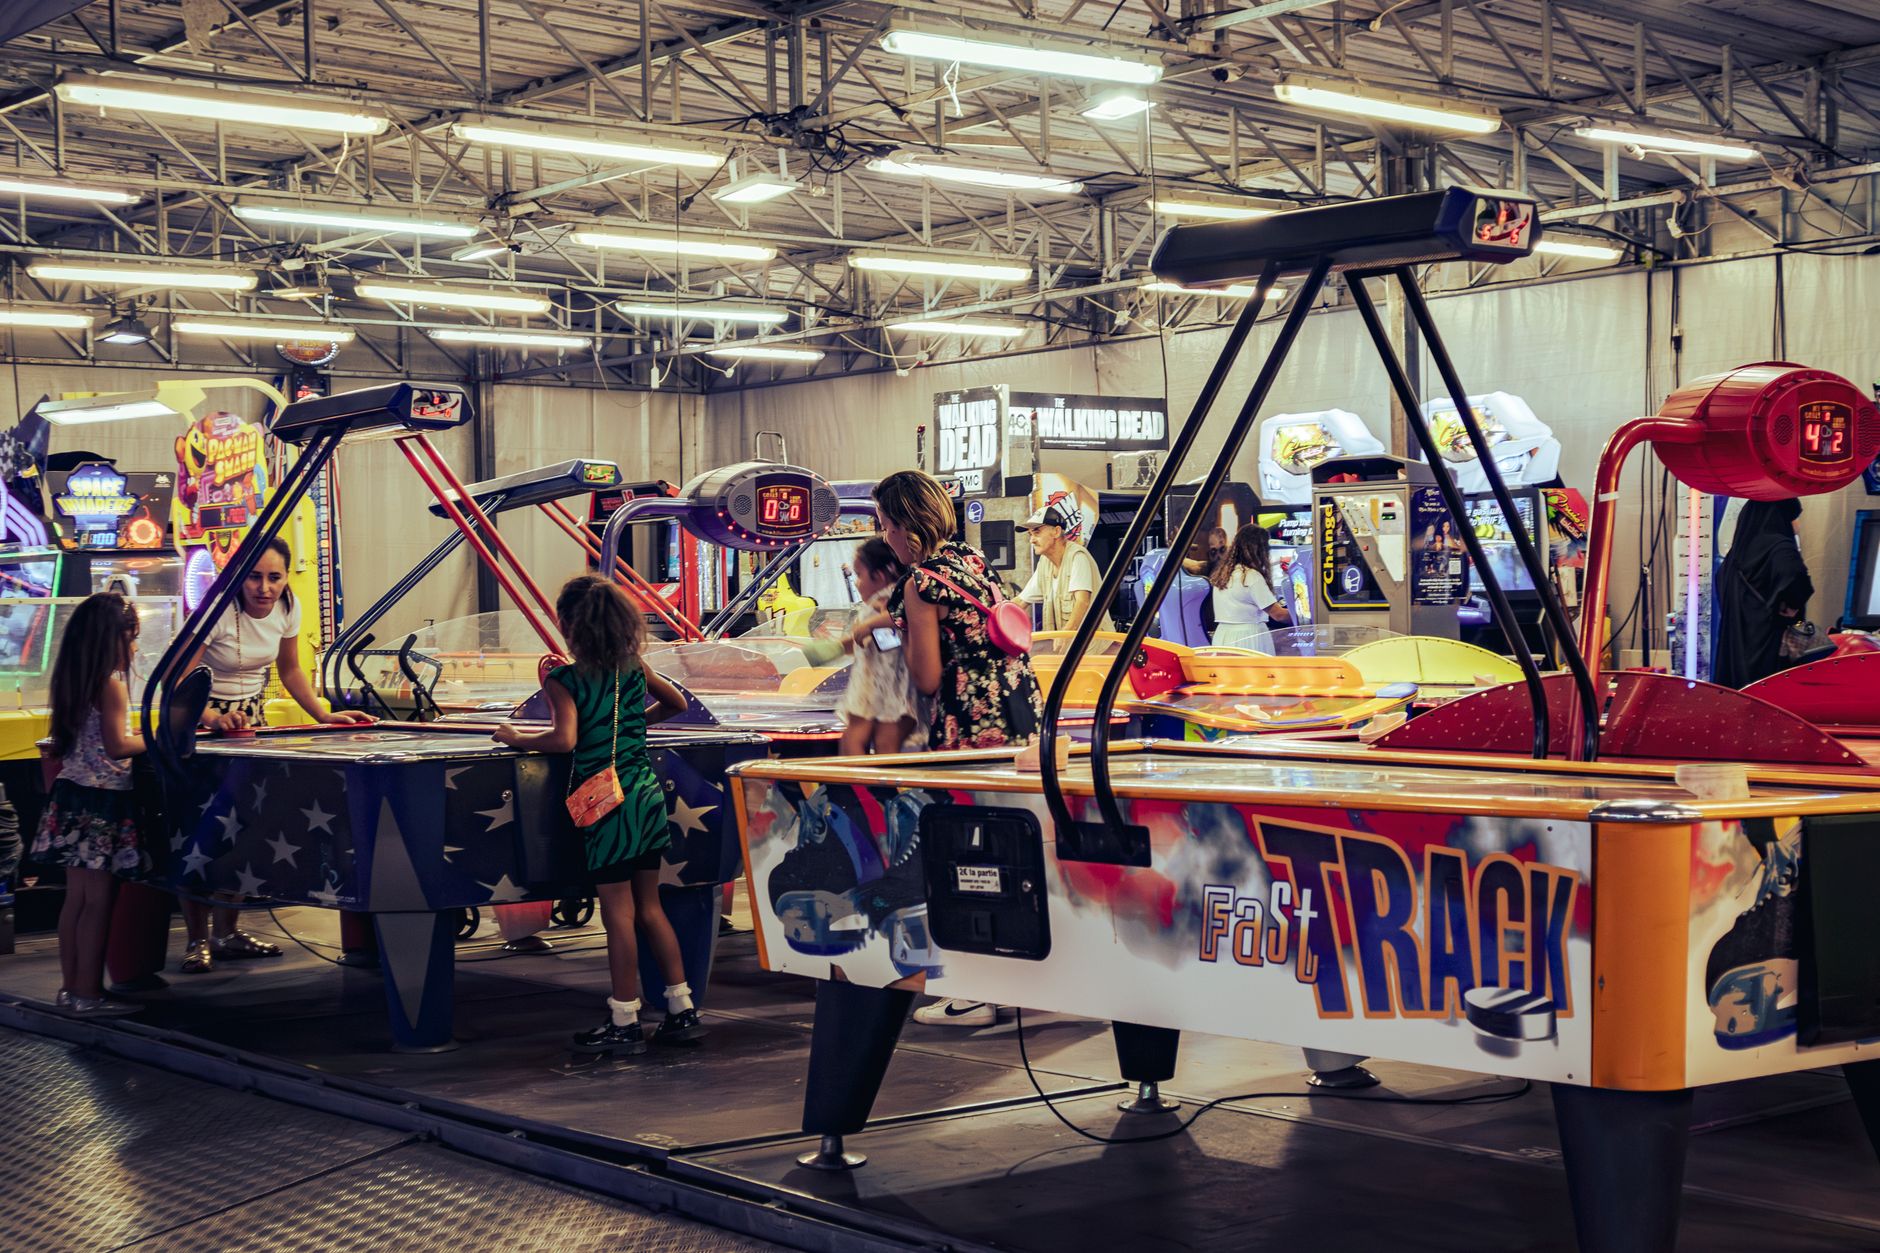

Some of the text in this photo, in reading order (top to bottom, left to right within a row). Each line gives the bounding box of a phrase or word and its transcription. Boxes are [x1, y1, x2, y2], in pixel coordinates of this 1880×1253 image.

[939, 399, 997, 430] WALKING
[1054, 397, 1066, 409] THE
[1036, 406, 1118, 440] WALKING
[1117, 409, 1165, 440] DEAD
[939, 424, 997, 471] DEAD
[1805, 423, 1820, 451] 4
[1832, 431, 1844, 452] 2
[69, 477, 125, 497] SPACE
[56, 498, 137, 515] INVADERS
[764, 500, 778, 519] 0
[790, 505, 800, 518] 0
[1323, 505, 1336, 585] Change
[1251, 814, 1581, 1020] TRACK
